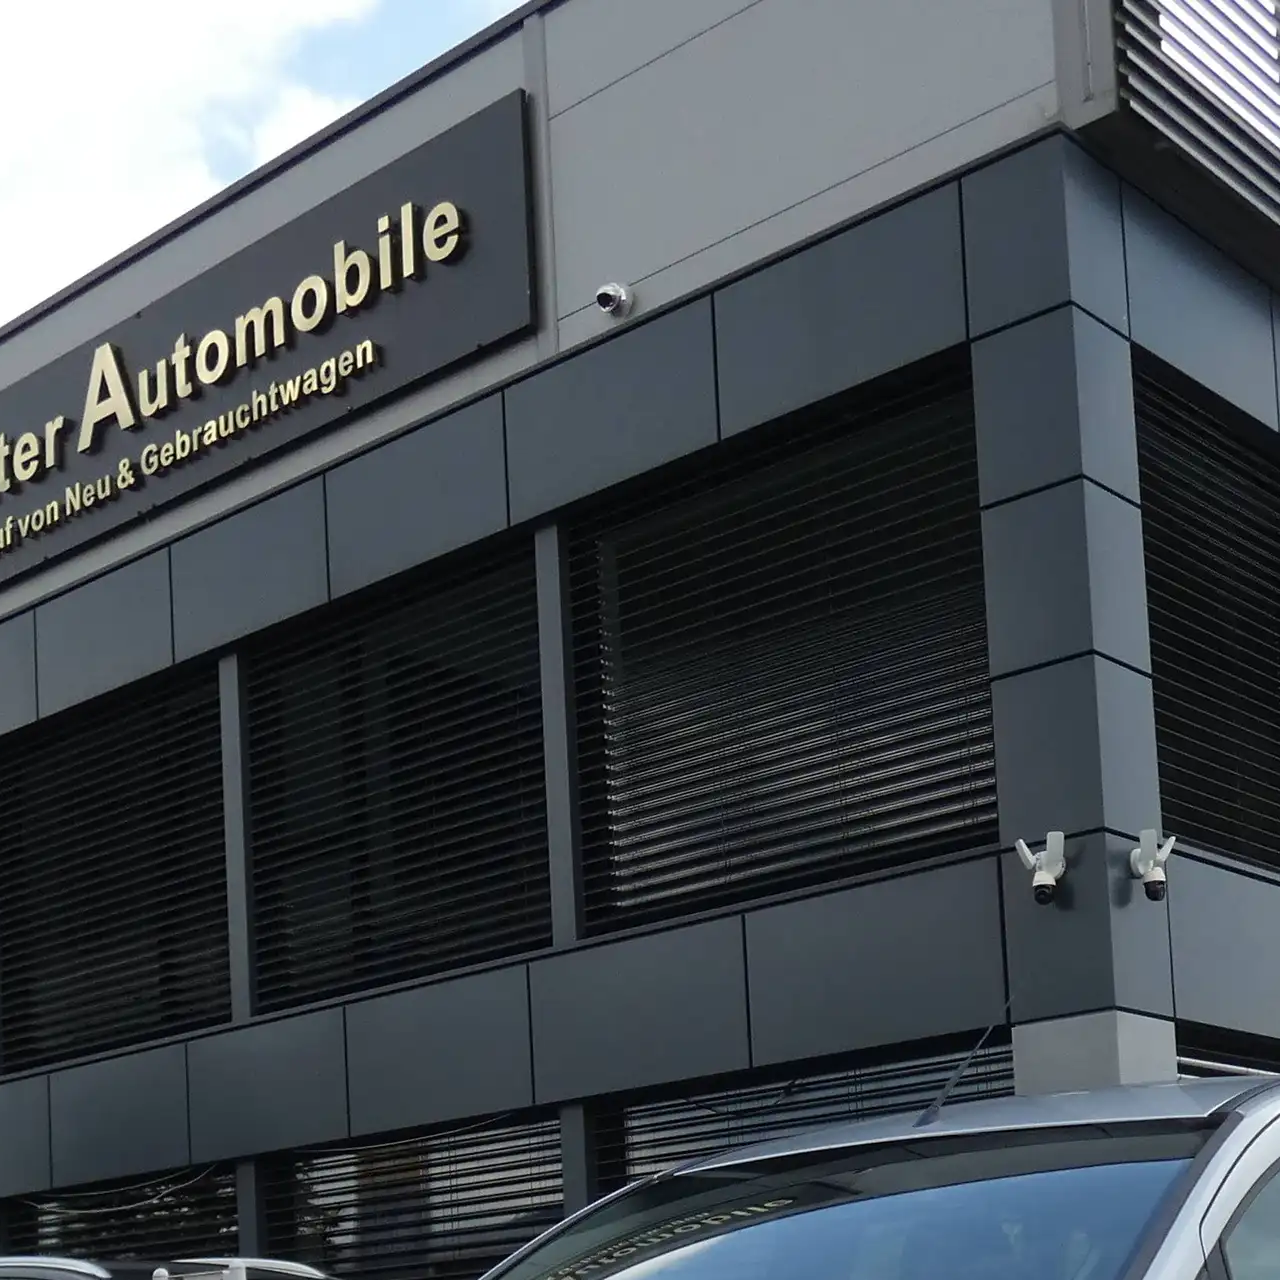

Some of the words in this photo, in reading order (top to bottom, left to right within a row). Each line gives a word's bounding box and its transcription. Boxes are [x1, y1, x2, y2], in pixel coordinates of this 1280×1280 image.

[17, 500, 60, 538] von
[65, 474, 111, 517] Neu
[117, 457, 136, 490] &
[140, 339, 374, 476] Gebrauchtwagen
[77, 200, 461, 452] Automobile
